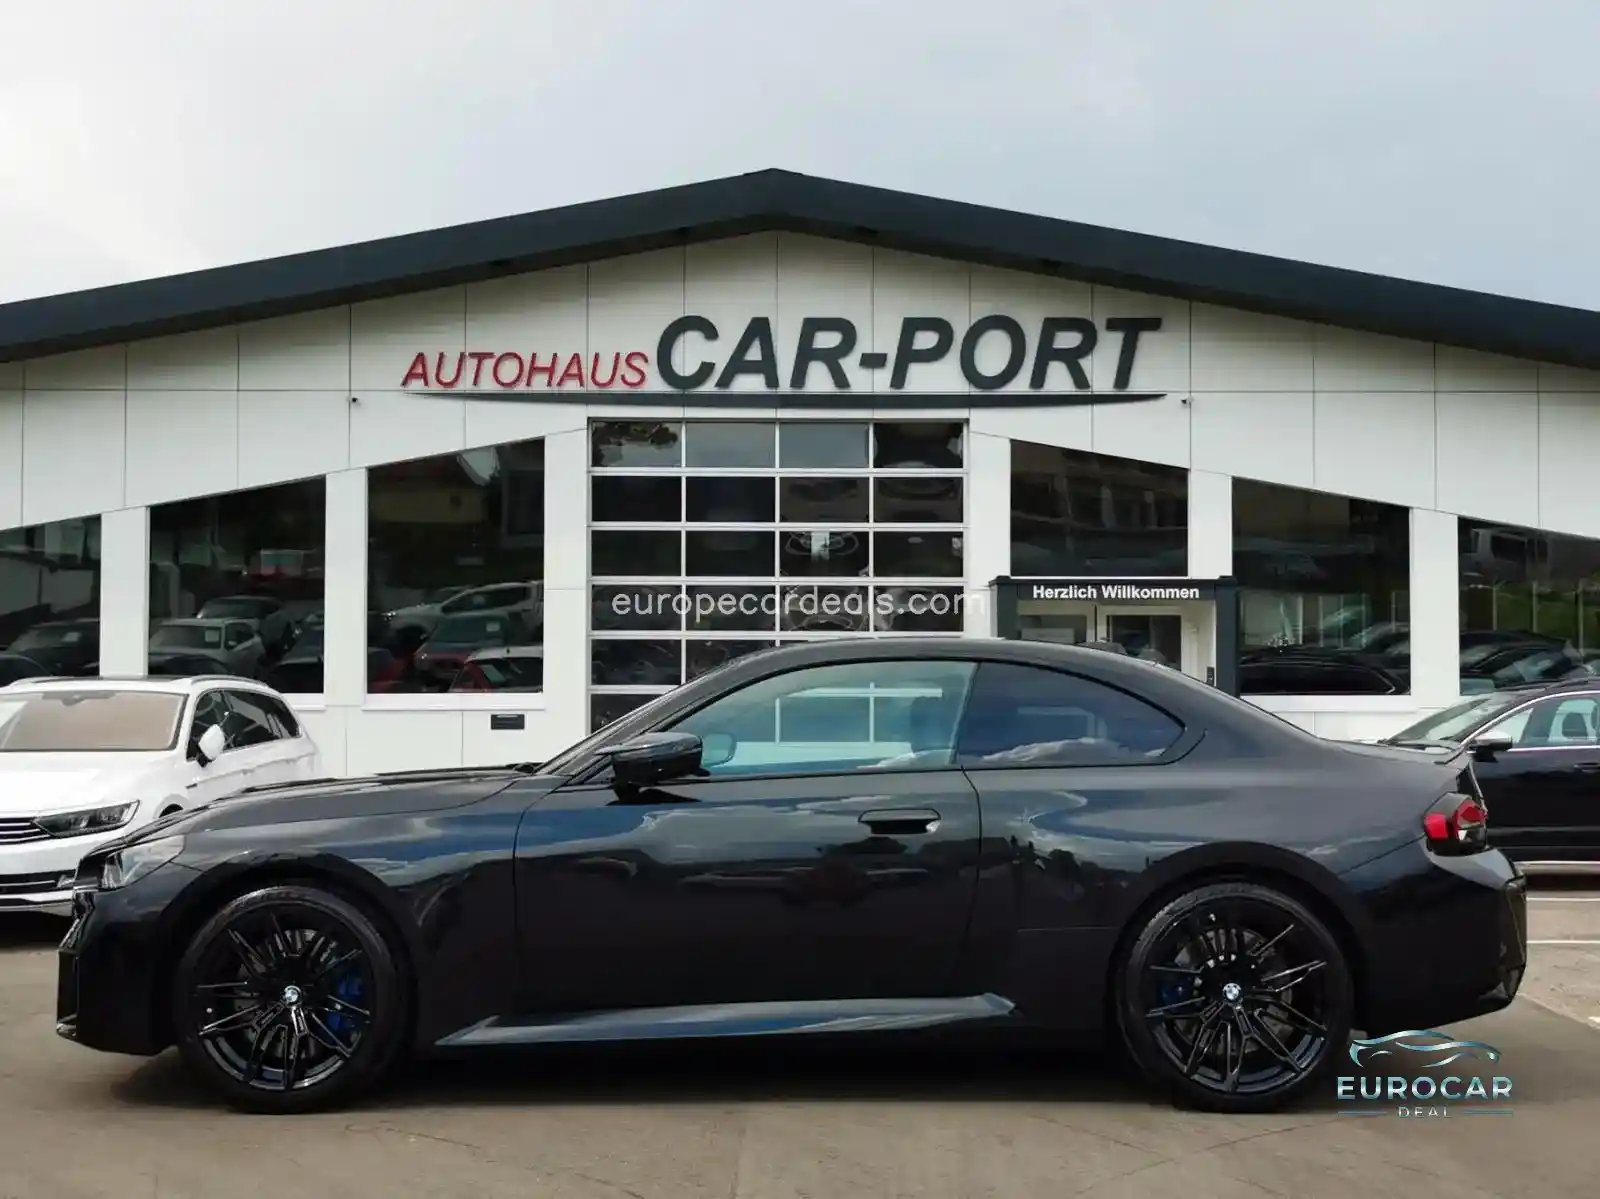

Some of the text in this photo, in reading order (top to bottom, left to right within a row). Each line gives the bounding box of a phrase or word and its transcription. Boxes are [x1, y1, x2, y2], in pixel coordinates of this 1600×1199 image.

[402, 314, 1163, 391] AUTOHAUS CAR-PORT
[1032, 584, 1200, 599] Herzlich Willkommen
